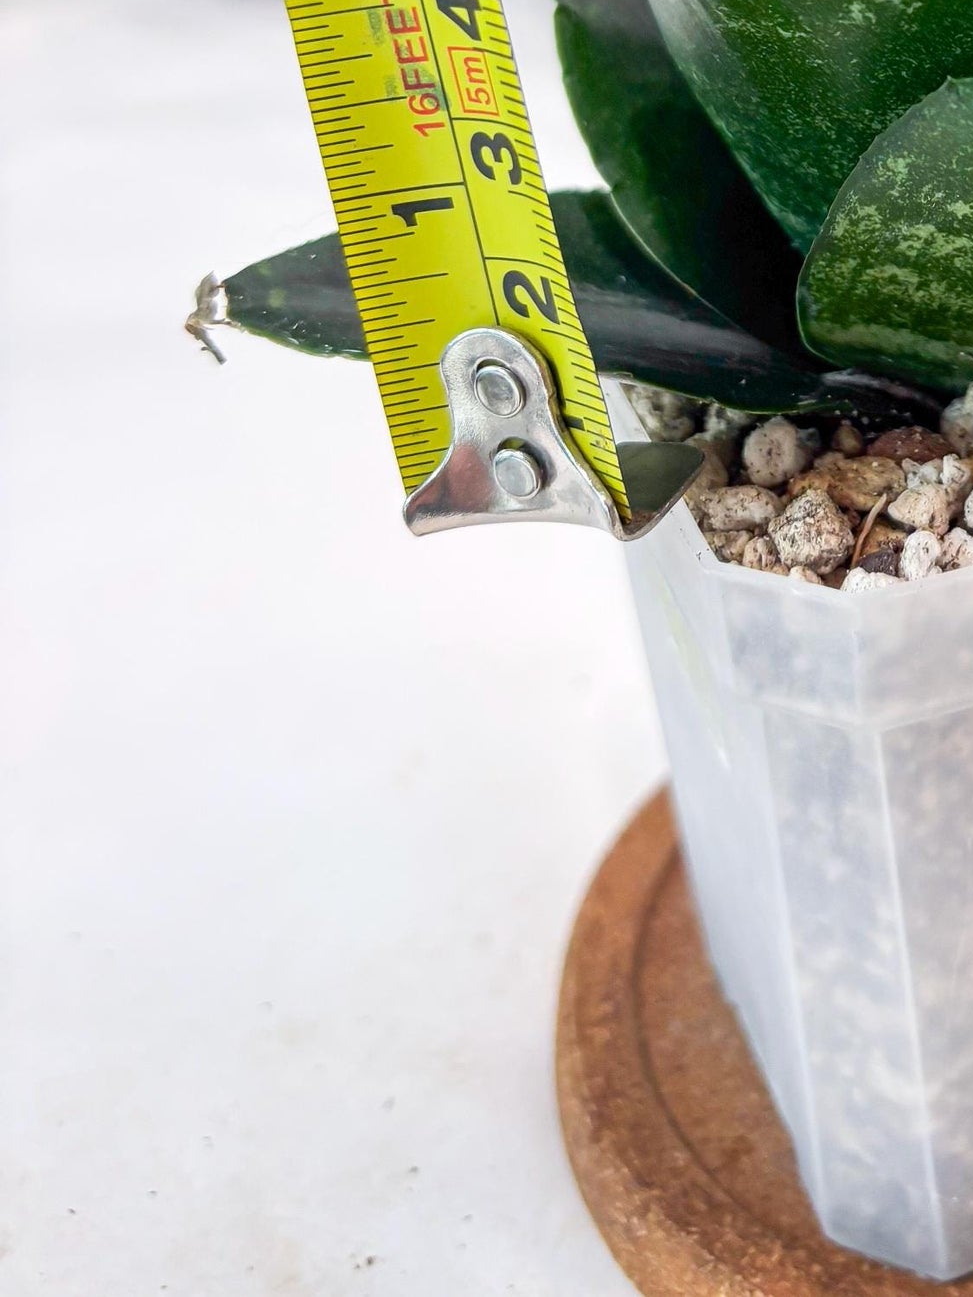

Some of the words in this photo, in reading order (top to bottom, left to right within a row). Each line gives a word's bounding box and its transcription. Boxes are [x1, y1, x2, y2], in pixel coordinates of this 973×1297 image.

[459, 55, 493, 107] 5m
[470, 130, 523, 186] 3
[391, 196, 455, 229] 1
[501, 268, 561, 325] 2
